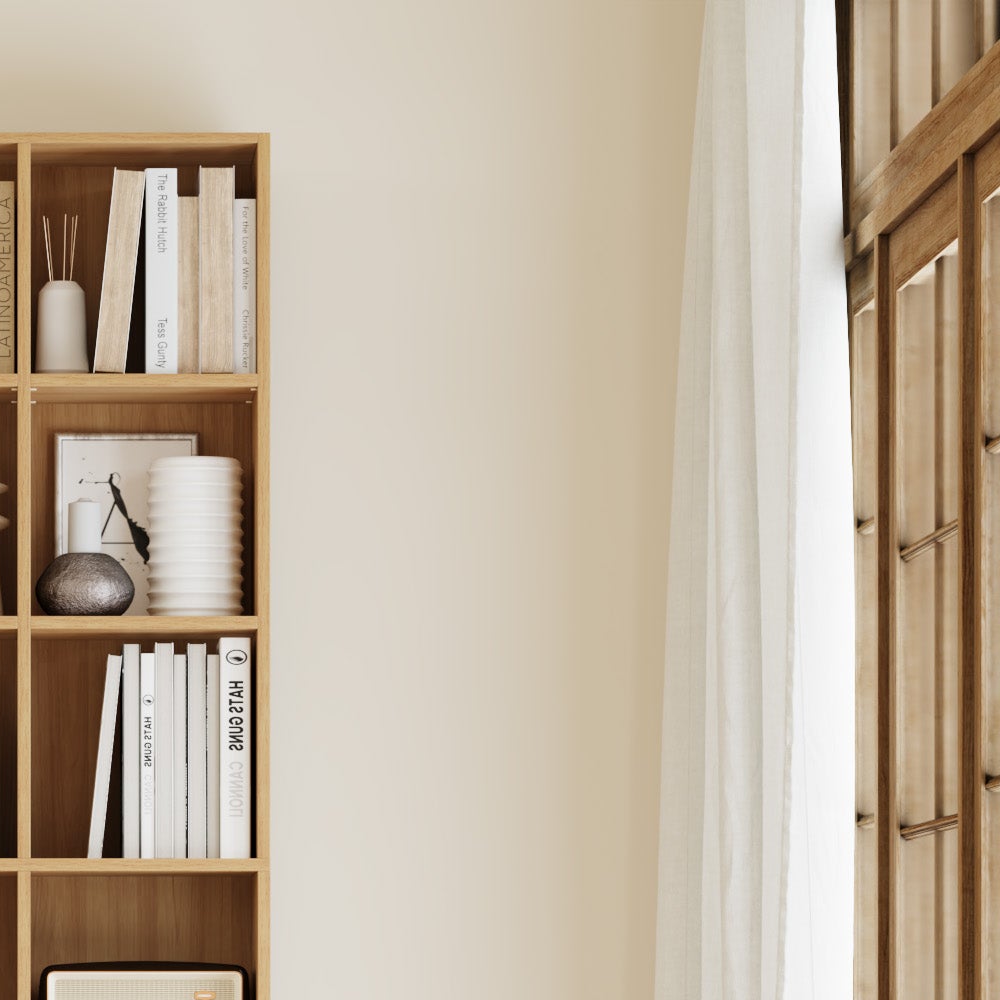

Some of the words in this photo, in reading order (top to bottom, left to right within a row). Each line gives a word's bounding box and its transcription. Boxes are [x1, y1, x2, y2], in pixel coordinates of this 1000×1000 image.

[157, 174, 168, 191] The
[157, 194, 168, 223] Rabbit
[242, 206, 250, 220] For
[242, 221, 250, 234] the
[157, 226, 168, 253] Hutch
[242, 236, 250, 255] Love
[242, 257, 250, 265] of
[242, 267, 250, 290] White
[157, 318, 168, 338] Tess
[242, 309, 250, 340] Chrissie
[155, 341, 168, 369] Gunty
[242, 342, 250, 369] Rucker
